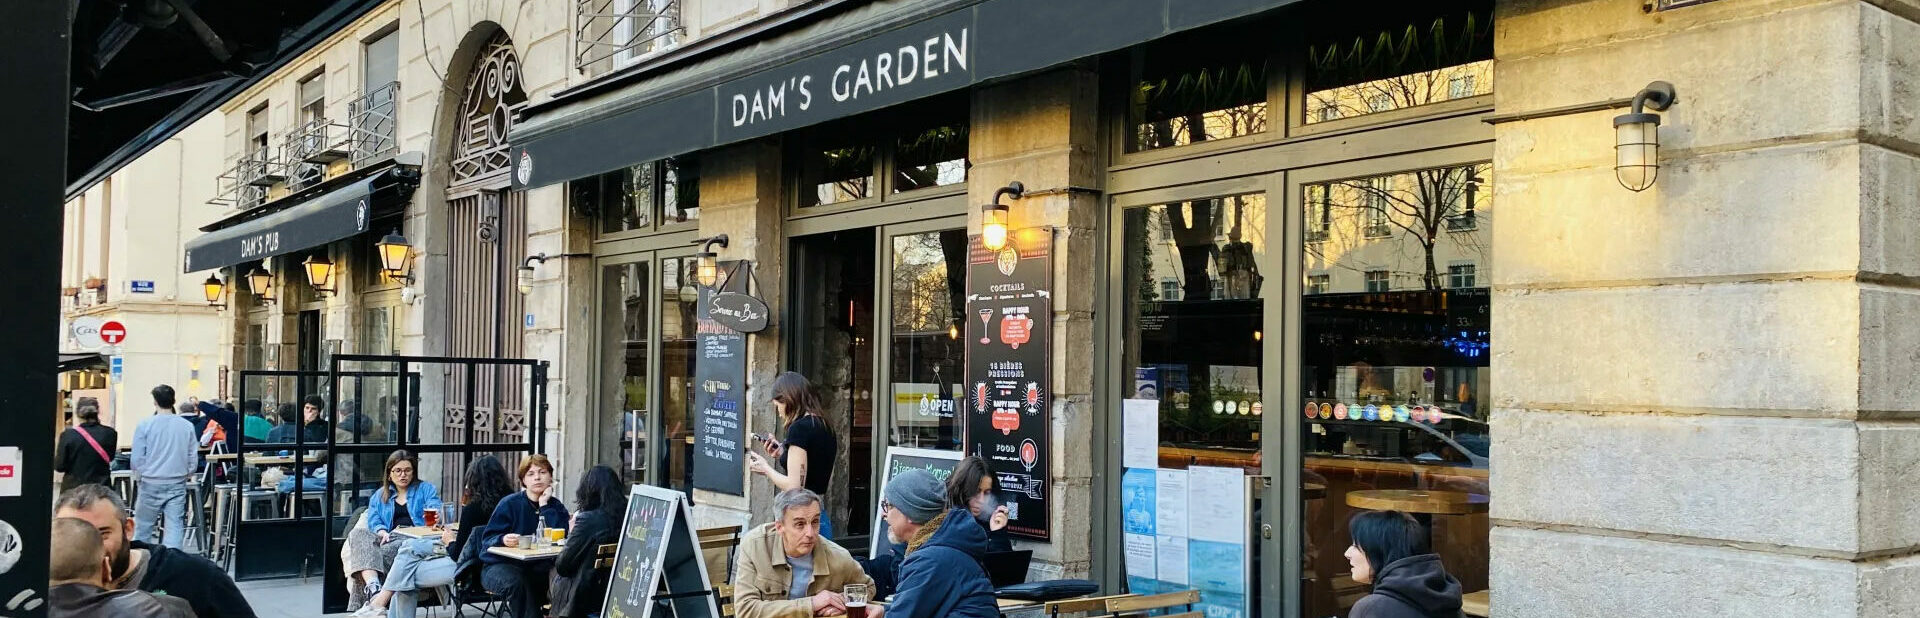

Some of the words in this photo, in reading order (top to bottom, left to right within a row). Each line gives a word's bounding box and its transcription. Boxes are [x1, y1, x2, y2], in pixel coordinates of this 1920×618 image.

[732, 75, 812, 128] DAM'S
[831, 28, 968, 102] GARDEN
[241, 235, 263, 258] DAM'S
[265, 231, 279, 254] PUB
[990, 283, 1025, 293] COCKTAILS
[930, 399, 954, 412] OPEN
[996, 443, 1016, 453] FOOD
